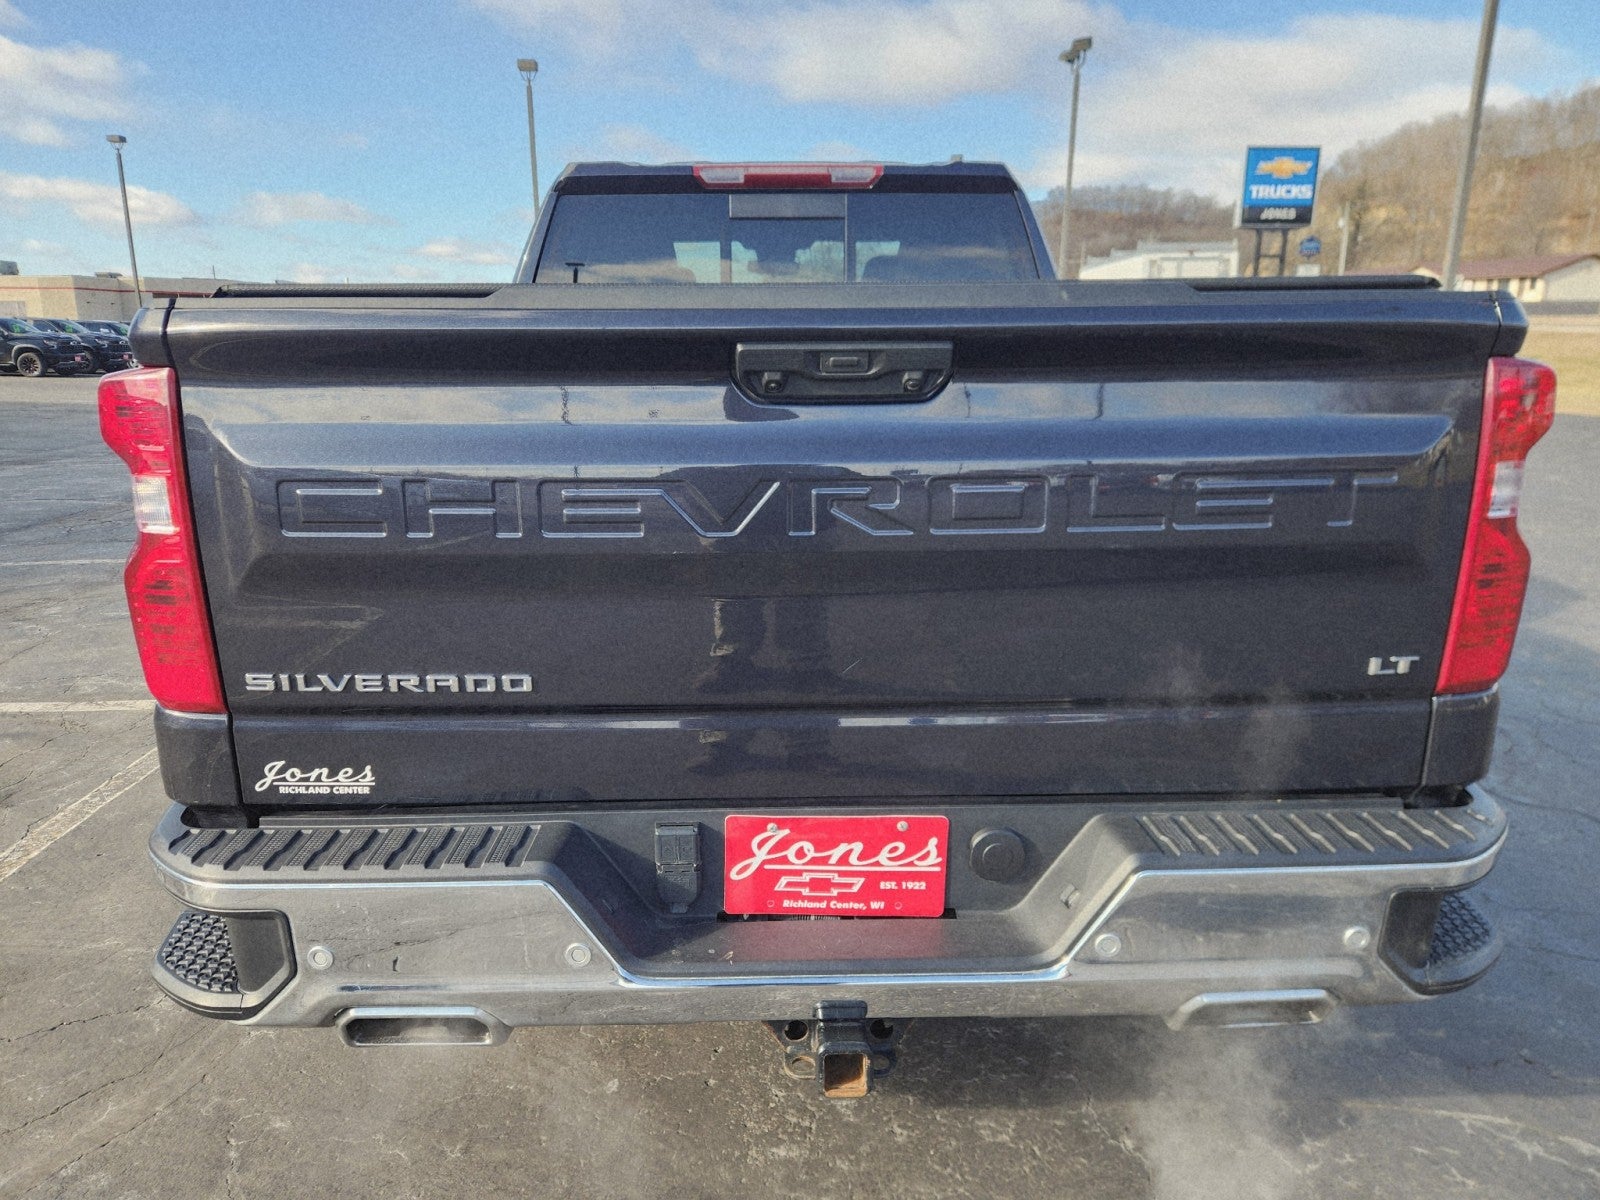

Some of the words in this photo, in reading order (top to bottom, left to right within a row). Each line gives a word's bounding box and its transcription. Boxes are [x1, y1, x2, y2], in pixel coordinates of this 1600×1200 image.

[1249, 184, 1314, 199] TRUCKS
[276, 468, 1399, 538] CHEVROLET
[1367, 656, 1420, 676] LT
[244, 672, 533, 692] SILVERADO
[254, 760, 376, 792] Jones
[278, 785, 330, 795] RICHLAND
[332, 785, 371, 795] CENTER
[729, 828, 943, 881] Jones
[879, 881, 898, 890] EST.
[901, 881, 926, 890] 1922
[782, 899, 827, 909] Richland
[829, 900, 868, 910] Center,
[870, 901, 885, 910] WI
